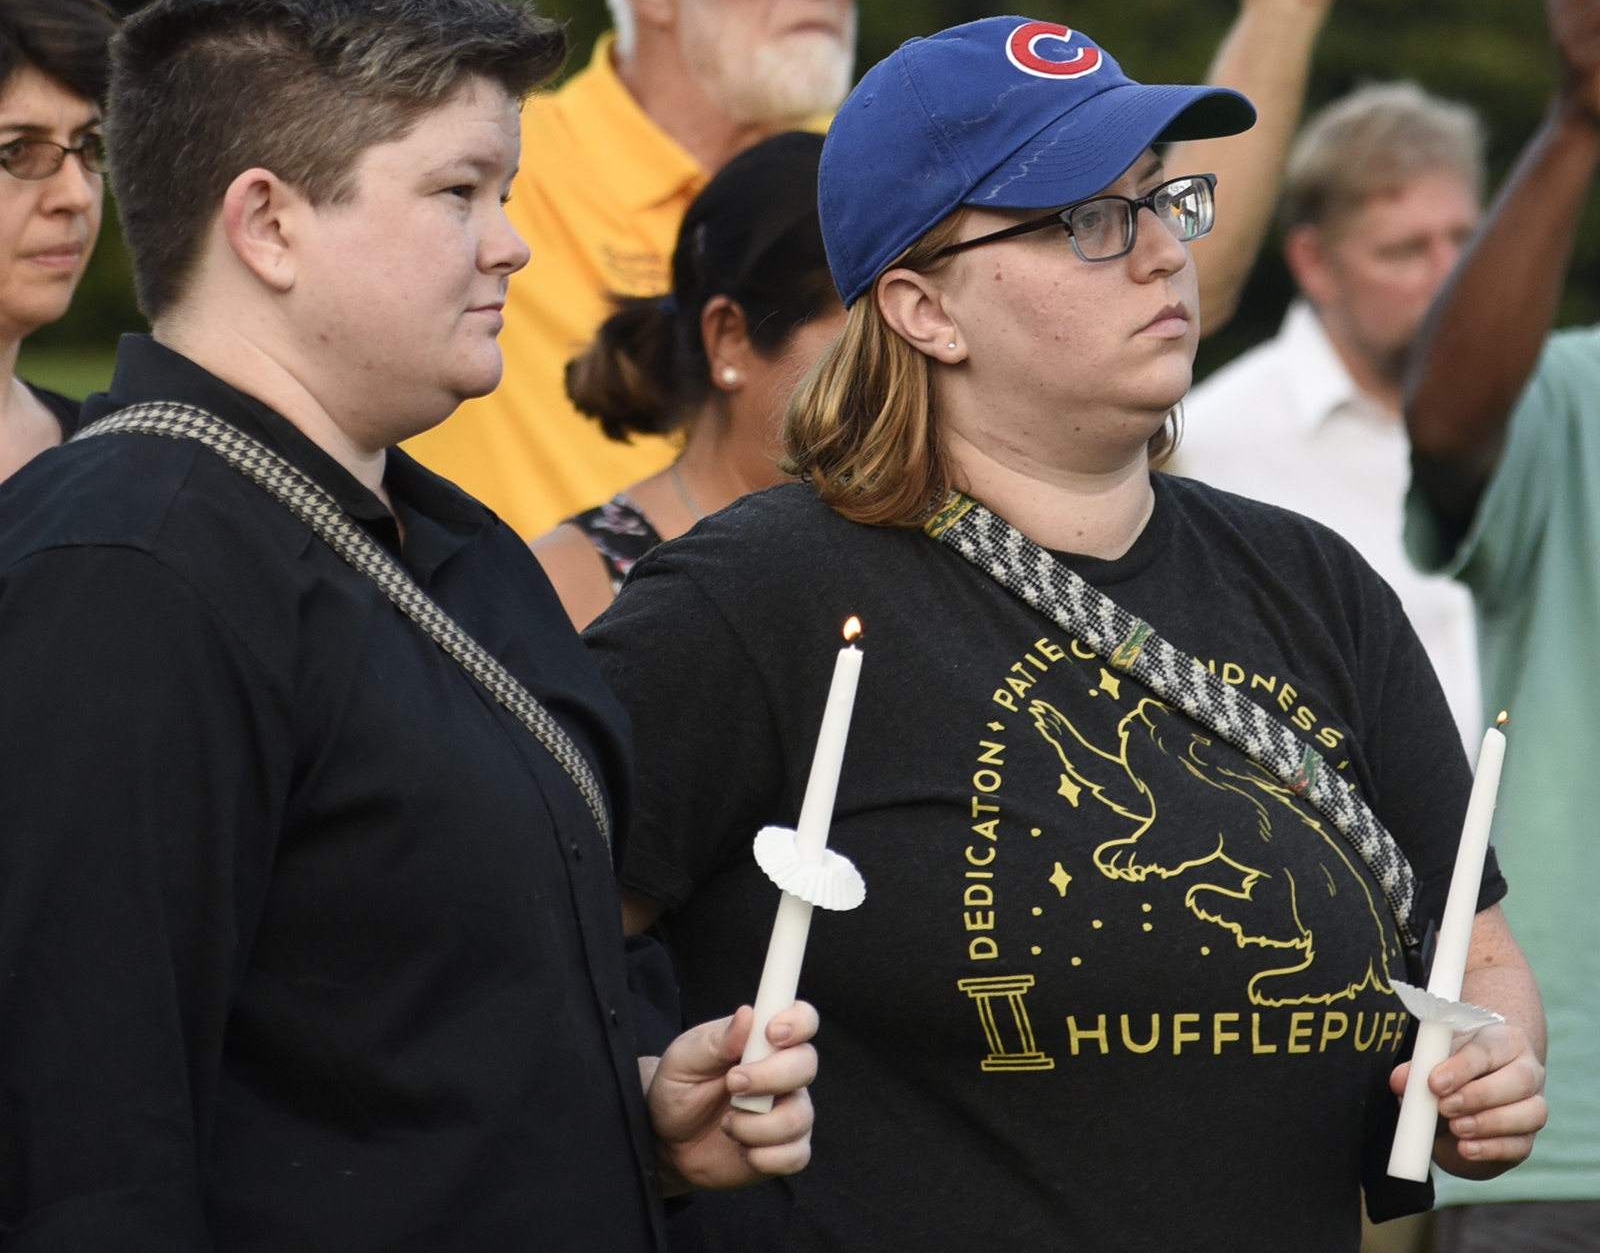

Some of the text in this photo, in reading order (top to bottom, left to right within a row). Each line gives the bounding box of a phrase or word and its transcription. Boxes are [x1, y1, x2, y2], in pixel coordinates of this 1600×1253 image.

[1005, 21, 1102, 80] C
[962, 740, 1006, 960] DEDICATON
[1065, 1010, 1408, 1056] HUFFLEPUFF
